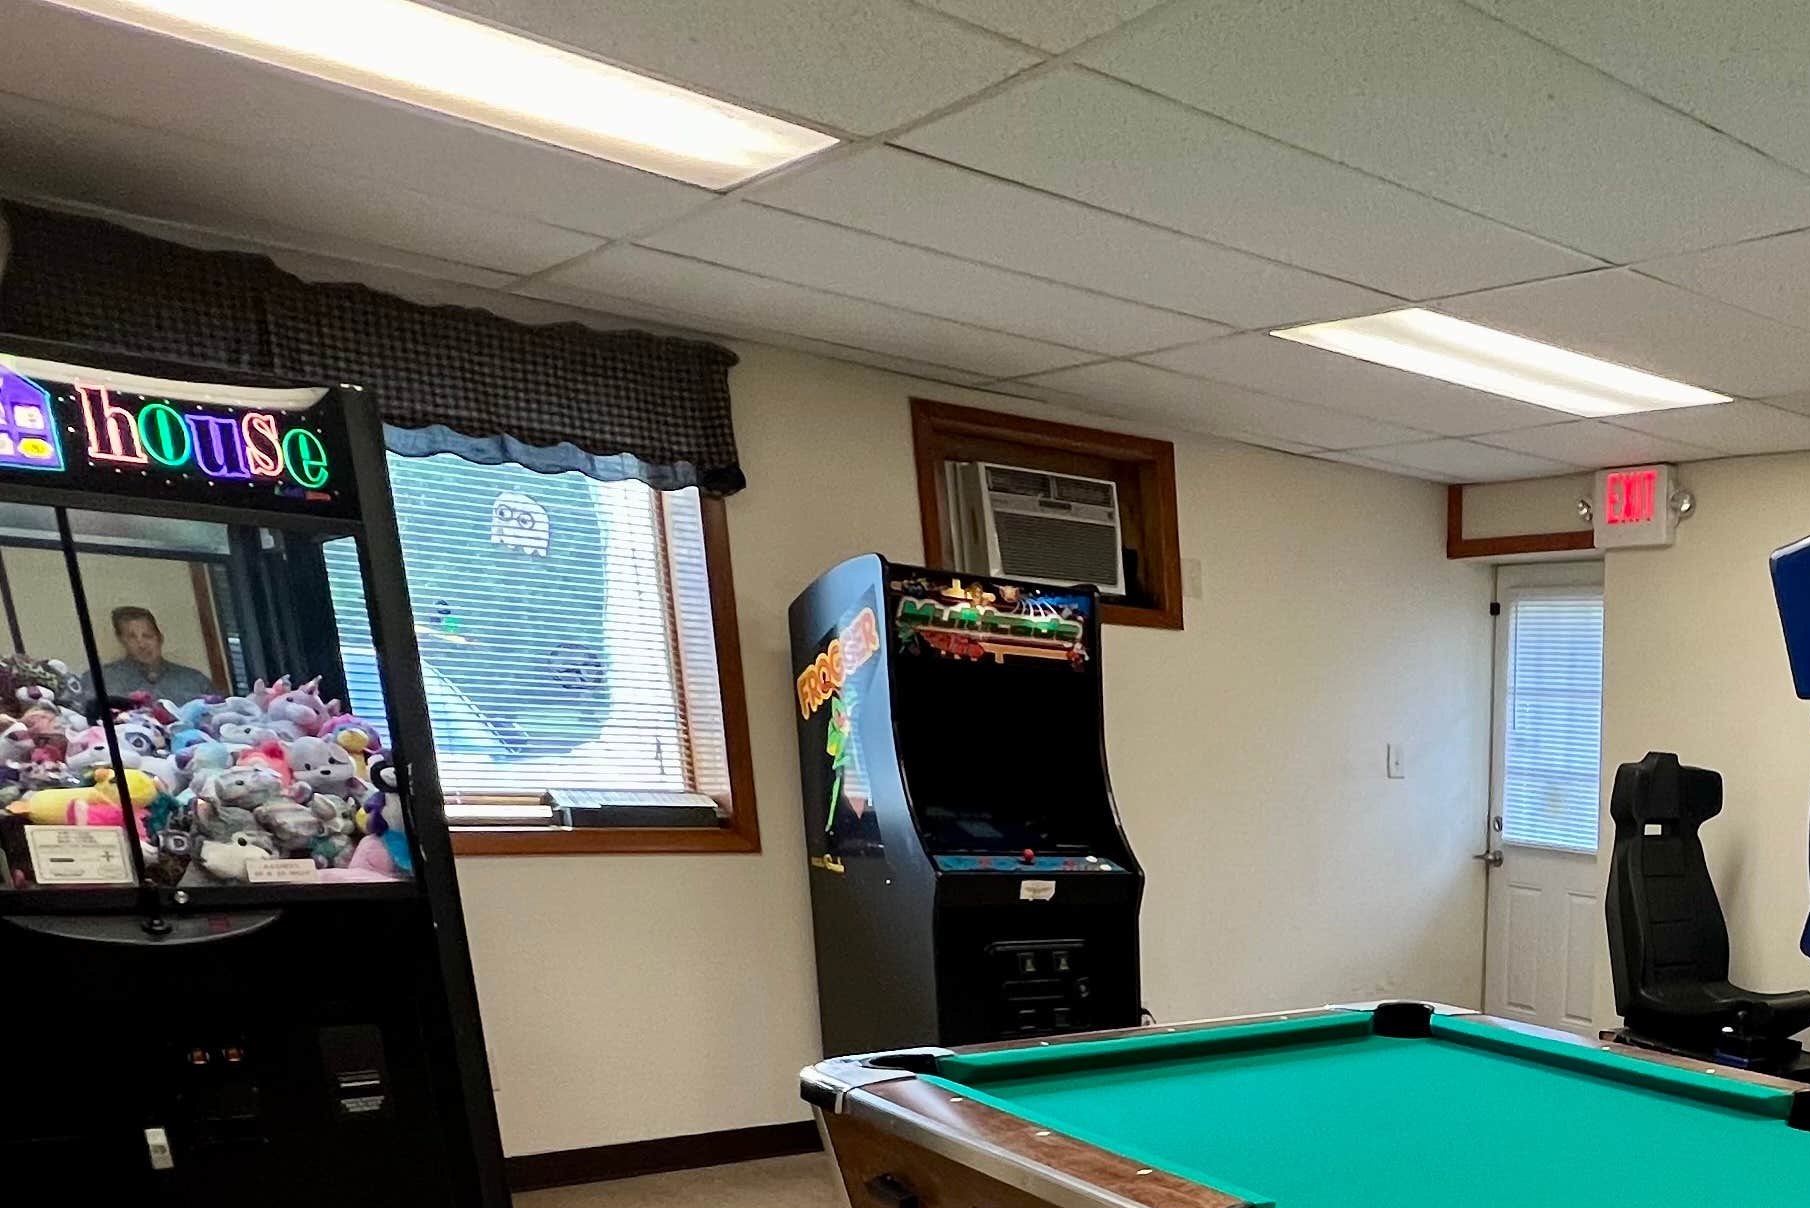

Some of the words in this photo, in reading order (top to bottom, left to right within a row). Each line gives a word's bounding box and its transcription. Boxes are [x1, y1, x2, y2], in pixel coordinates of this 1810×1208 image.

[74, 377, 329, 488] house
[1606, 470, 1657, 525] EXIT
[797, 608, 879, 720] FROGGER
